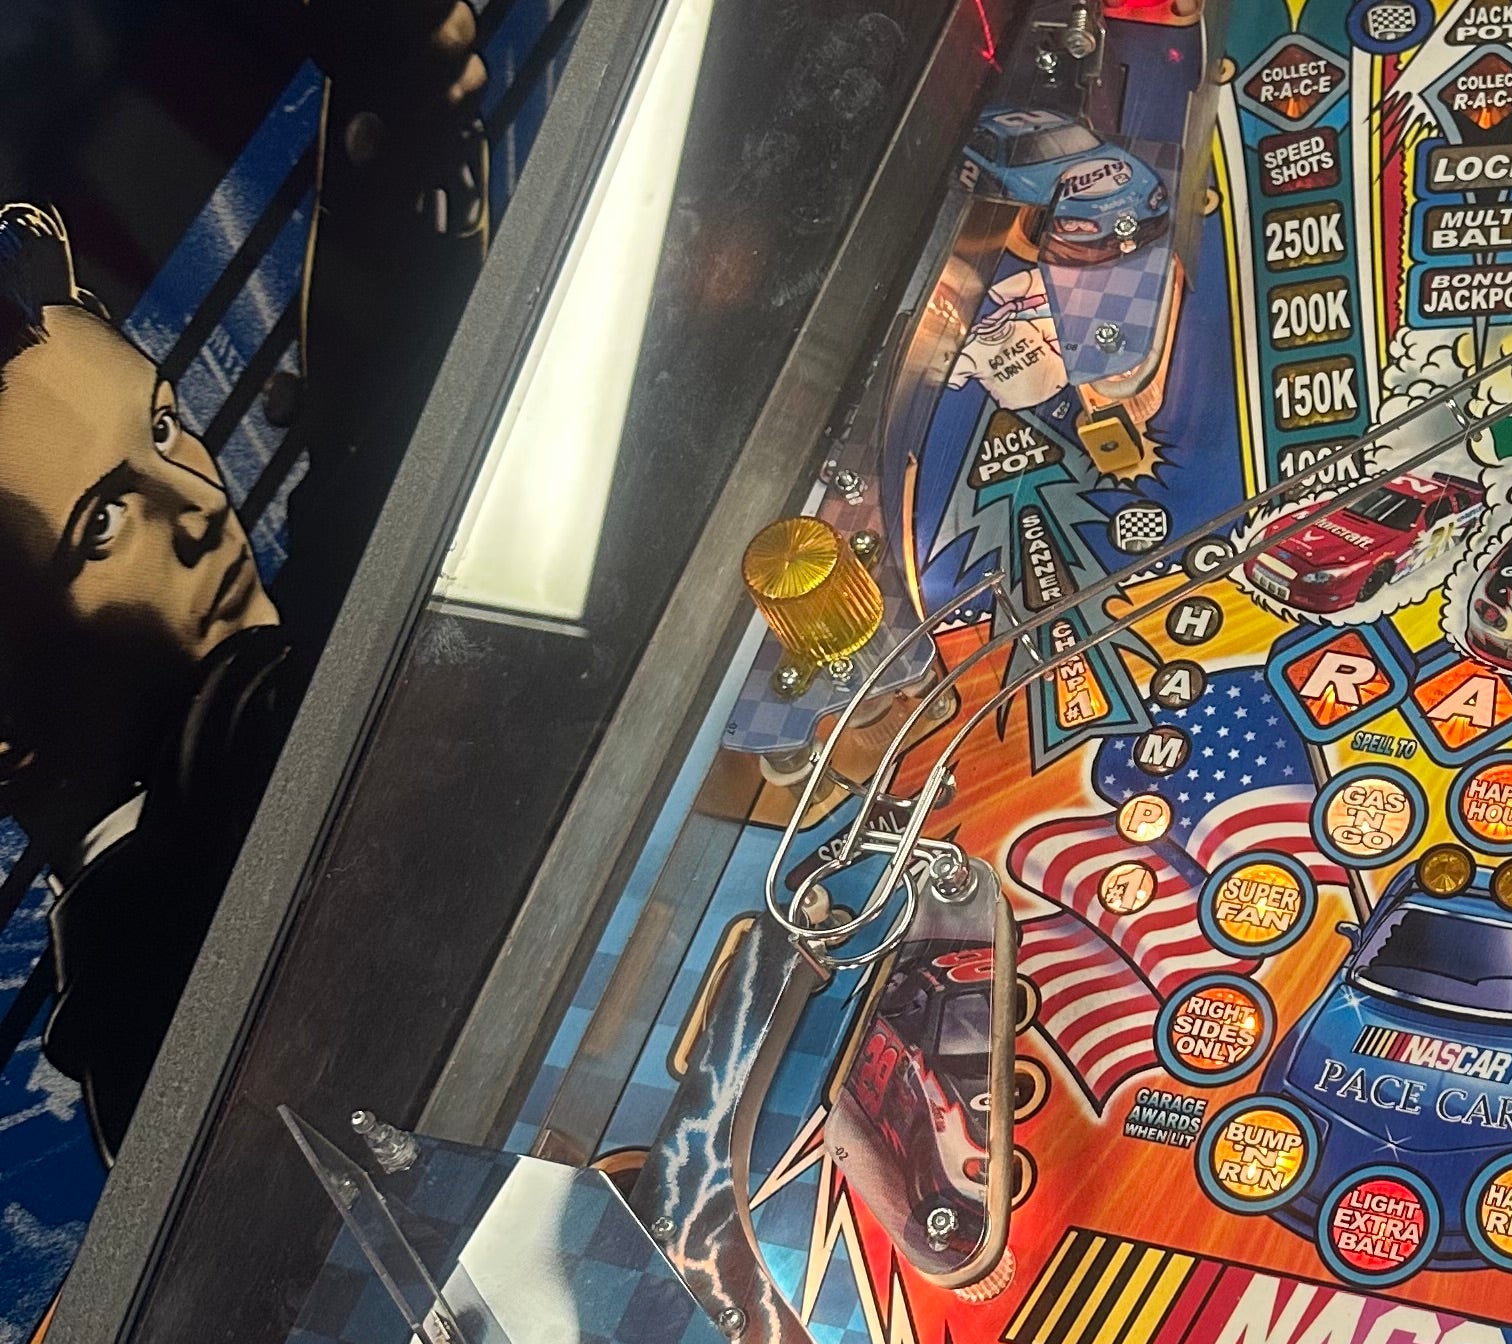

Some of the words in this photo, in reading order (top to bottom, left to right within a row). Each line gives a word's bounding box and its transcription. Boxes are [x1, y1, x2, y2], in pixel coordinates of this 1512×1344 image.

[1263, 135, 1325, 169] SPEED
[1270, 152, 1335, 185] SHOTS
[1264, 212, 1345, 263] 250K
[1270, 289, 1352, 341] 200K
[1274, 367, 1358, 421] 150K
[980, 426, 1038, 462] JACK
[978, 445, 1051, 482] POT
[1020, 514, 1062, 602] SCANNER
[1299, 651, 1377, 707] R
[1426, 676, 1498, 729] A
[1351, 730, 1393, 756] SPELL
[1342, 785, 1406, 812] GAS
[1331, 826, 1393, 851] GO
[1222, 877, 1301, 912] SUPER
[1215, 901, 1293, 933] FAN
[1186, 996, 1257, 1028] RIGHT
[1173, 1015, 1257, 1046] SIDES
[1314, 1058, 1425, 1115] PACE
[1225, 1121, 1303, 1151] BUMP
[1218, 1161, 1287, 1191] RUN
[1350, 1190, 1421, 1220] LIGHT
[1333, 1207, 1420, 1245] EXTRA
[1337, 1233, 1406, 1263] BALL
